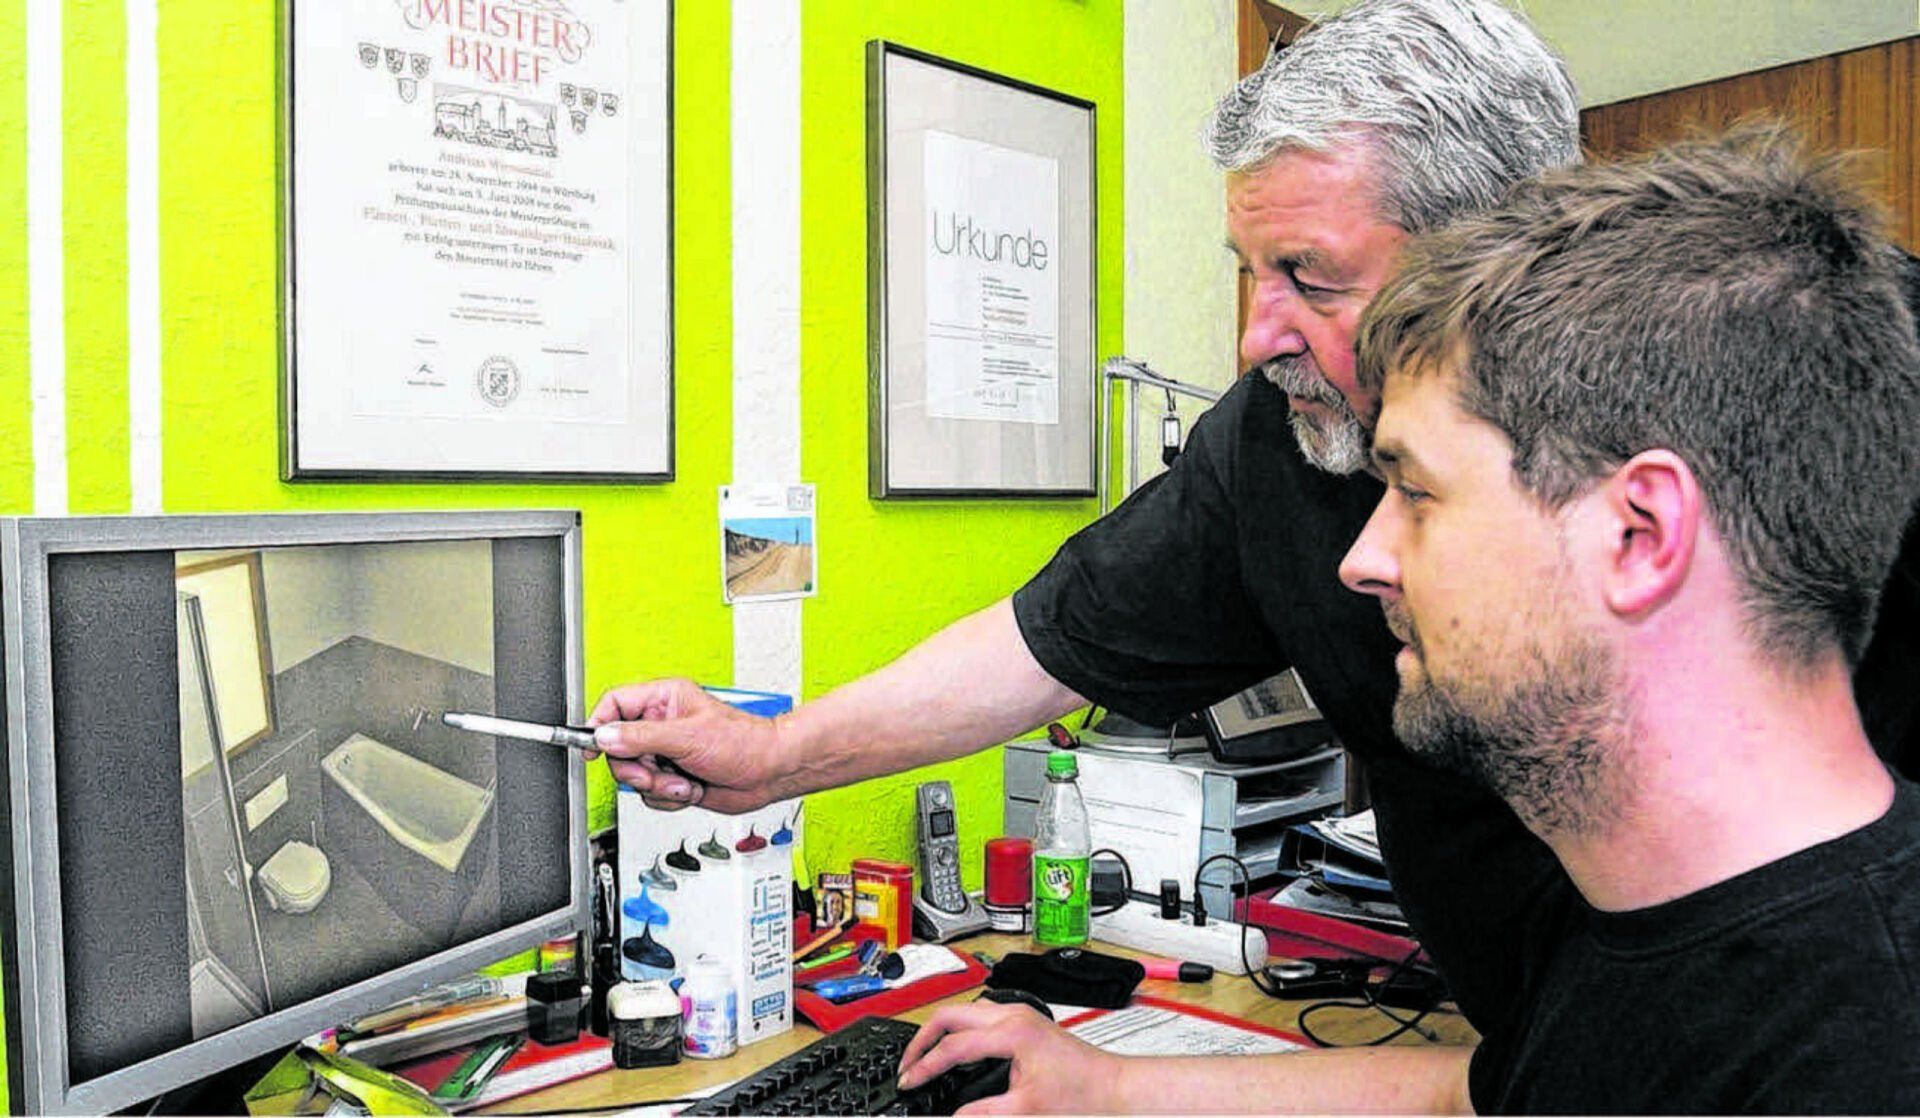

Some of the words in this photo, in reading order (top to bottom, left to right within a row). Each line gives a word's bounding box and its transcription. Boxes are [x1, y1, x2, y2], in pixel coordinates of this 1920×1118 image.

[406, 0, 588, 61] MEISTER
[448, 35, 551, 84] BRIEF
[933, 211, 1048, 270] Urkunde
